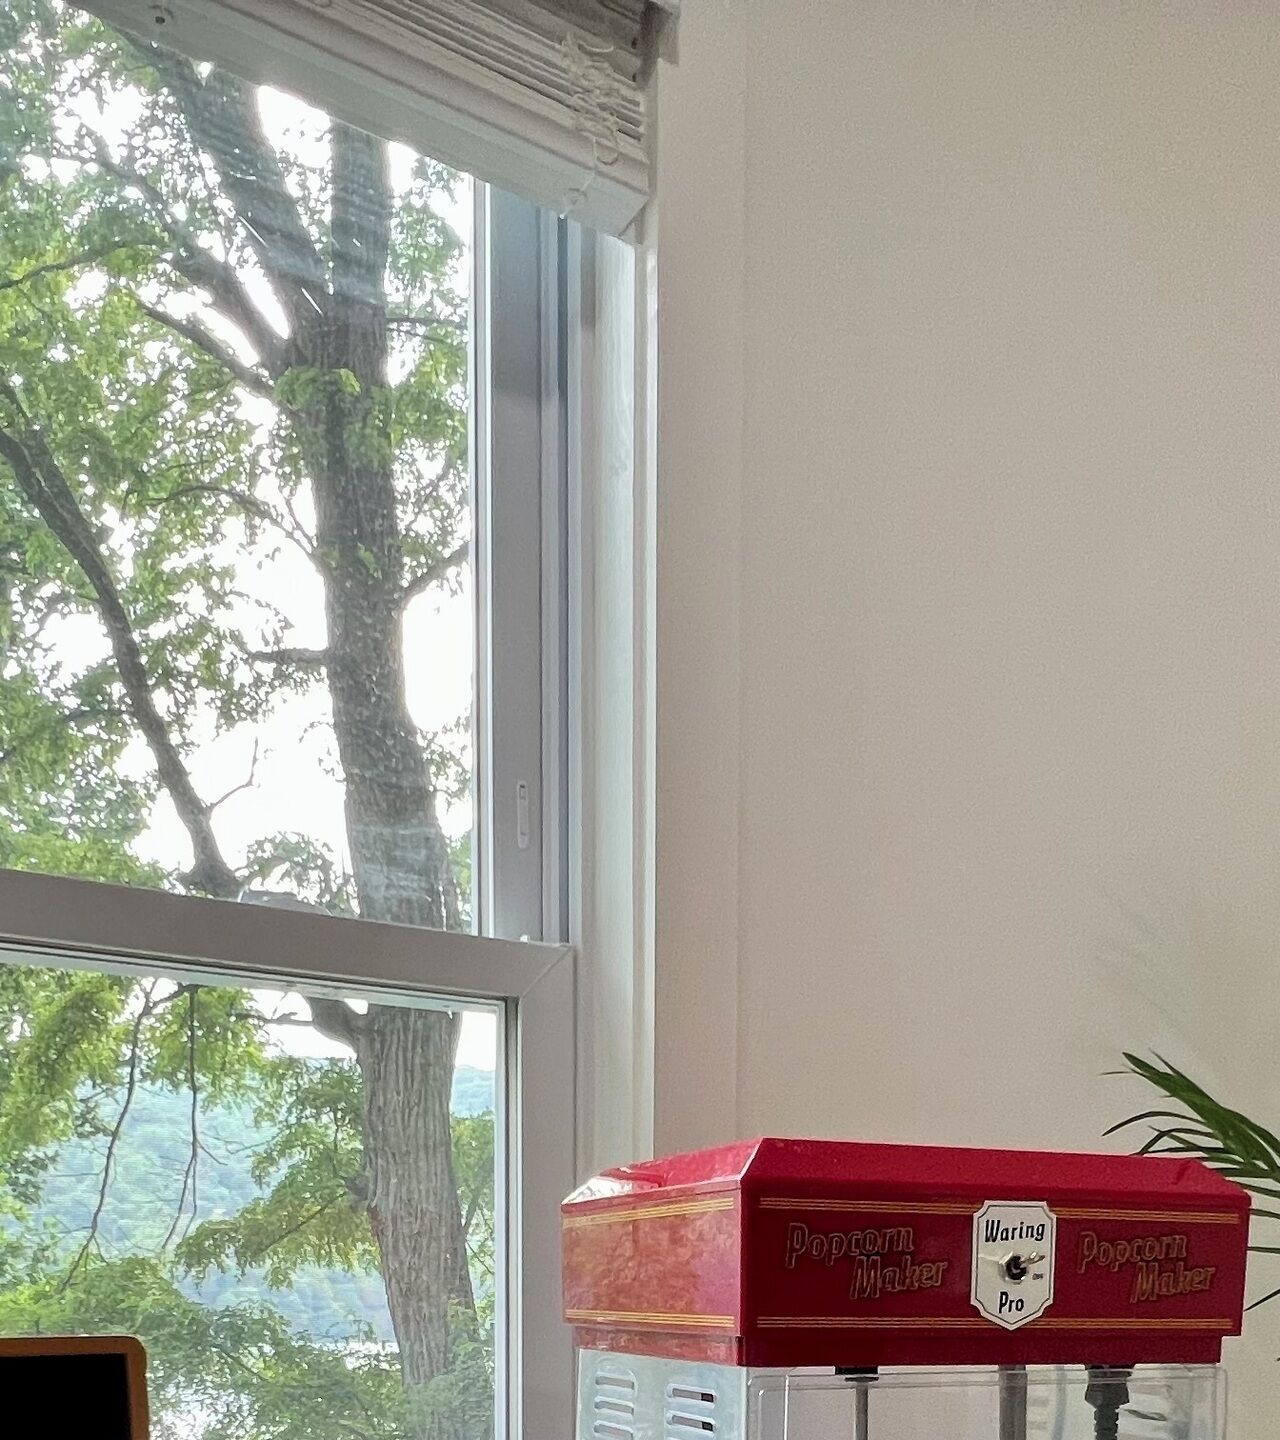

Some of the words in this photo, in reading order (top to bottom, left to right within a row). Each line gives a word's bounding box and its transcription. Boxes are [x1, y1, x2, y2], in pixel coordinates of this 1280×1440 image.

[786, 1223, 914, 1269] Popcorn
[985, 1219, 1045, 1242] Waring
[1077, 1231, 1187, 1273] Popcorn
[850, 1255, 948, 1299] Maker
[1129, 1261, 1216, 1303] Maker
[999, 1291, 1024, 1313] Pro
